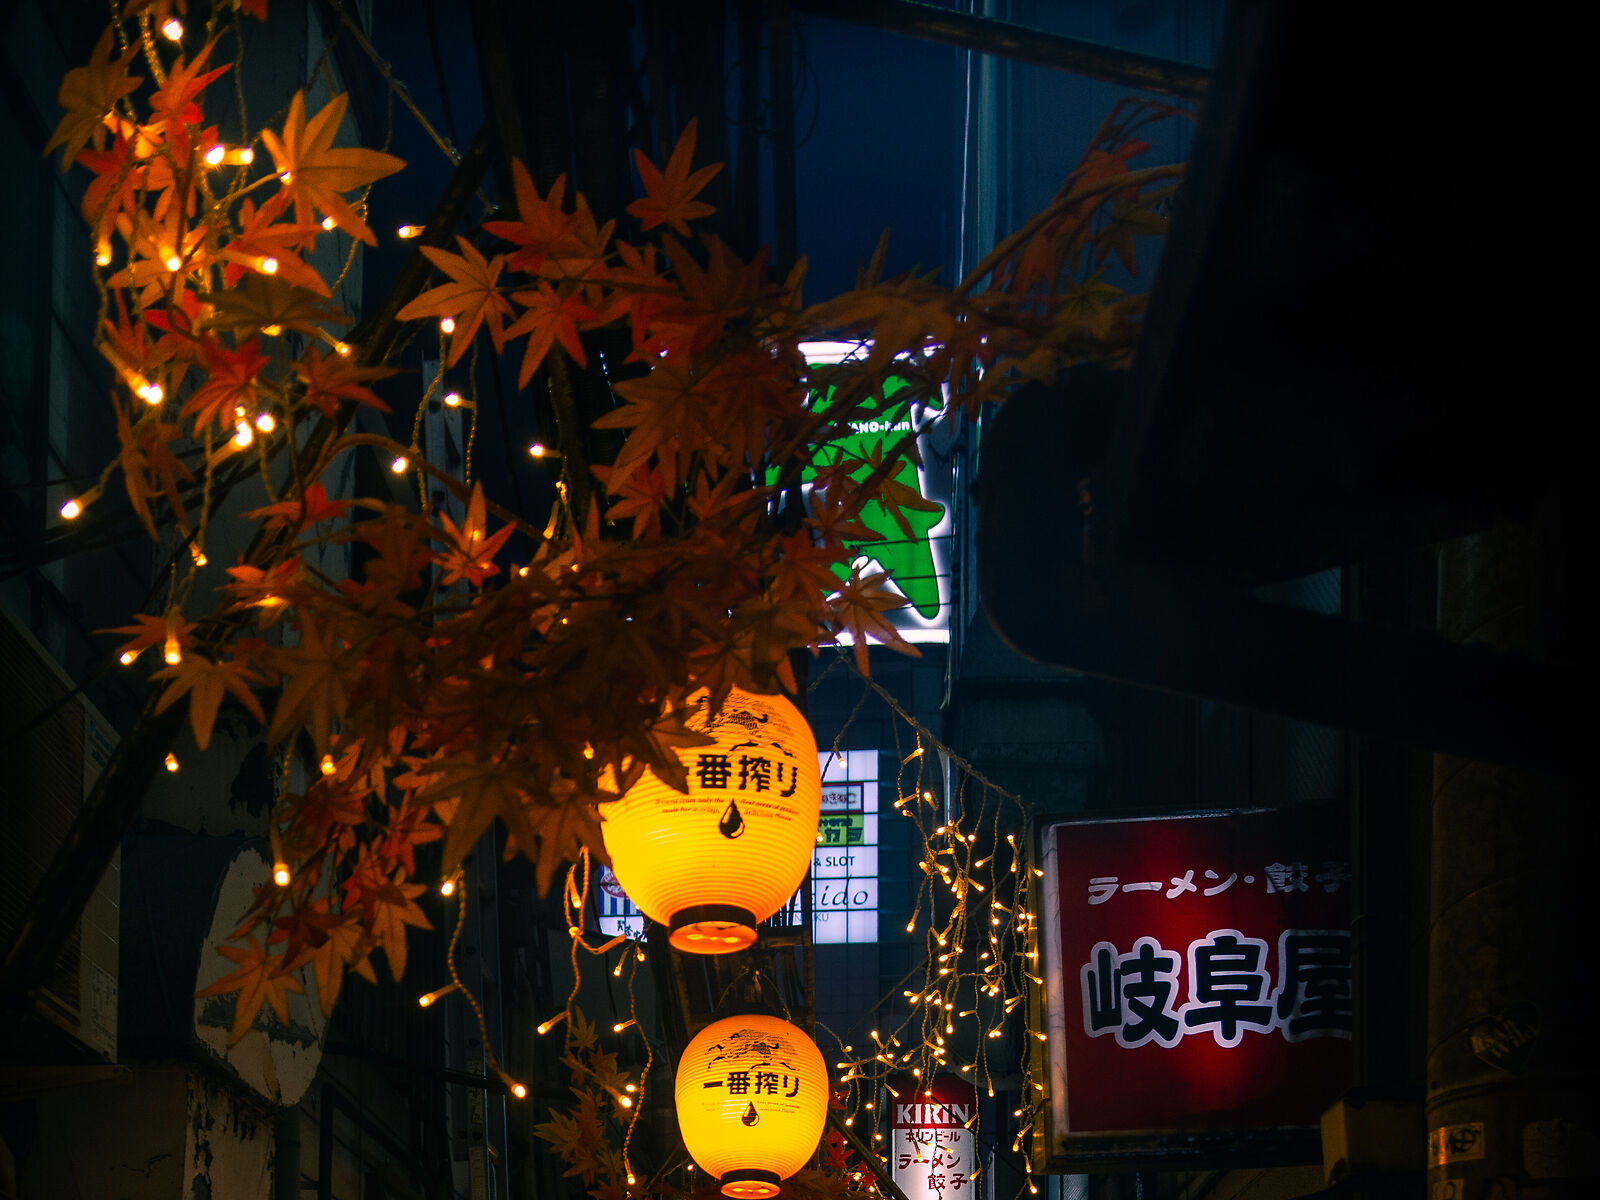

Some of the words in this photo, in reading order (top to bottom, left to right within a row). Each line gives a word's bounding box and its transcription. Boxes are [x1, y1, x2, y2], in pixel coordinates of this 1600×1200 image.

[688, 754, 797, 797] 番搾り
[825, 856, 855, 867] SLOT
[1080, 929, 1352, 1049] 岐阜屋
[703, 1071, 799, 1098] 一番搾り
[896, 1103, 970, 1125] KIRIN
[899, 1154, 961, 1169] ラーメン
[928, 1173, 968, 1190] 餃子
